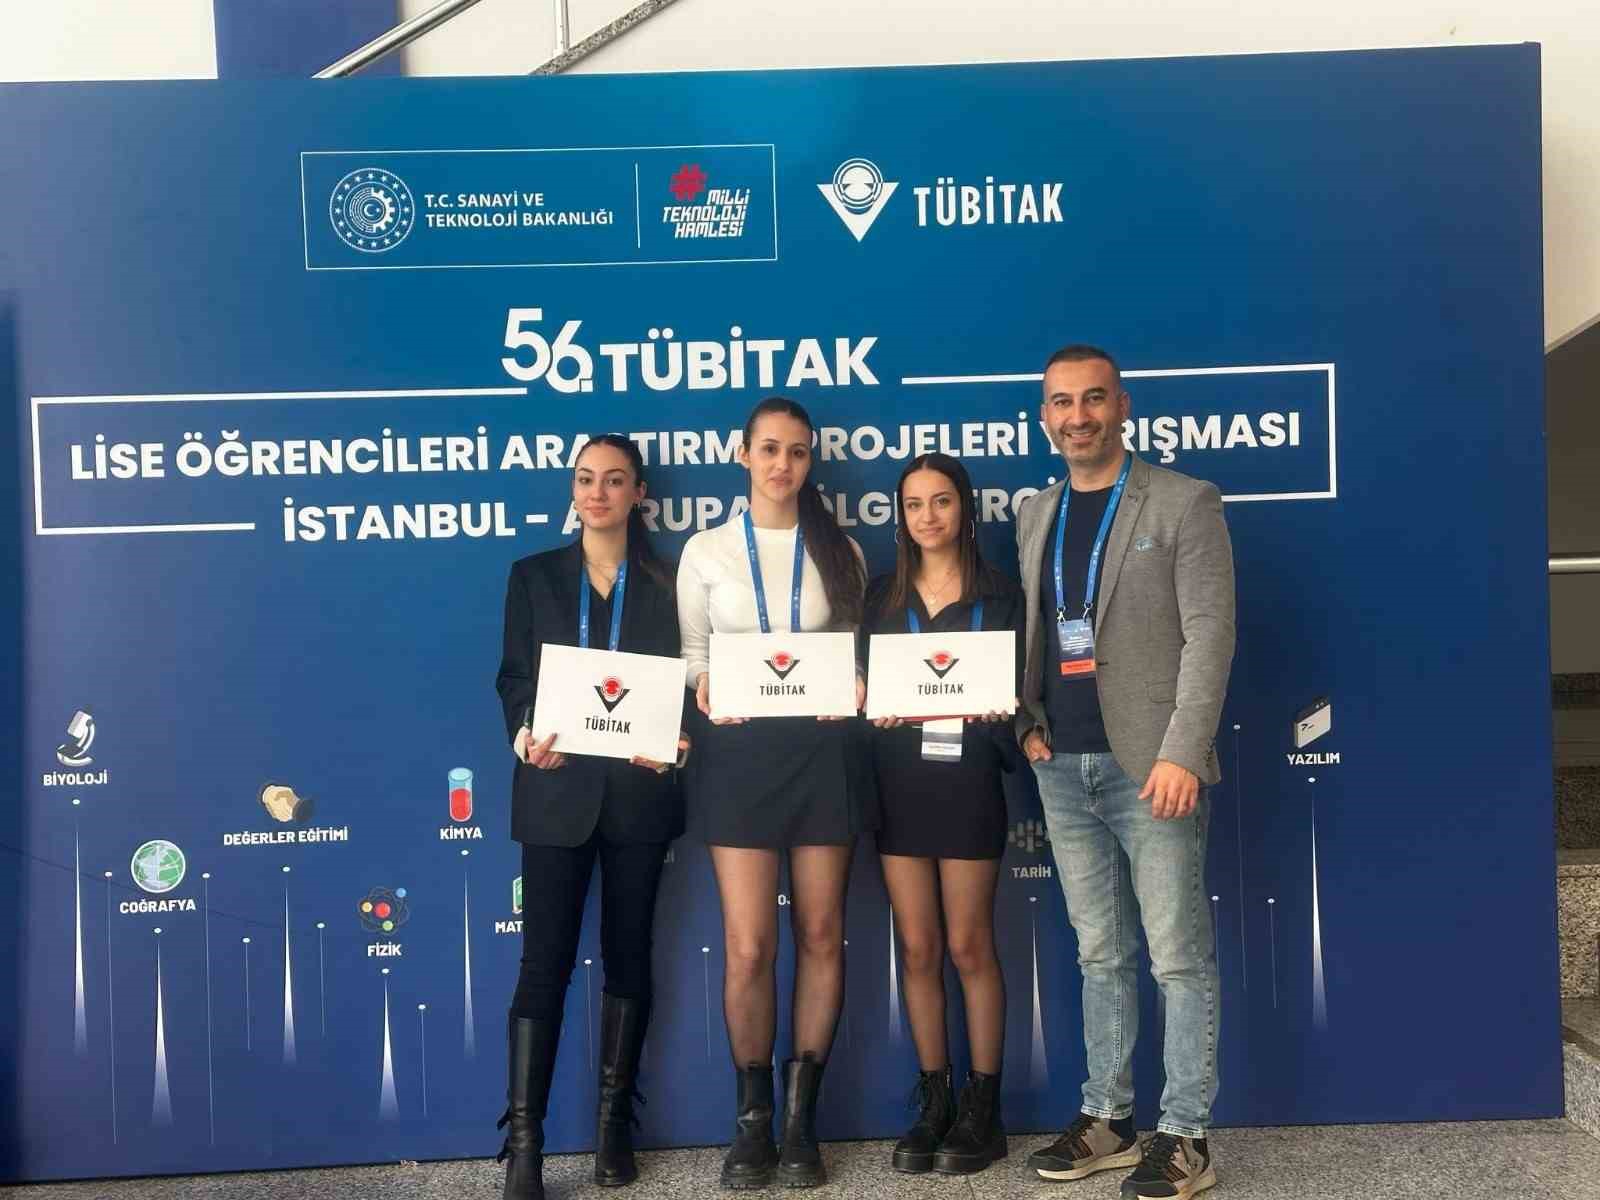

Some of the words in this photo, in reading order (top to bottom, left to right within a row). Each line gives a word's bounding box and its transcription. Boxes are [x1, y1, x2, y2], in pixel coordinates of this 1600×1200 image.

[424, 194, 454, 208] T.C.
[458, 190, 518, 208] SANAYİ
[523, 193, 544, 206] VE
[913, 176, 1064, 226] TÜBİTAK
[426, 210, 518, 228] TEKNOLOJİ
[523, 208, 613, 226] BAKANLIĞI
[662, 205, 747, 223] TEKNOLOJİ
[674, 220, 744, 238] HAMLESİ
[599, 325, 880, 391] TÜBİTAK
[71, 433, 165, 480] LİSE
[176, 425, 488, 478] ÖĞRENCİLERİ
[499, 430, 744, 470] ARTIRM
[811, 411, 1029, 461] ROJELERİ
[1039, 411, 1300, 464] RIŞMASI
[283, 496, 516, 542] İSTANBUL
[759, 682, 806, 697] TÜBİTAK
[918, 680, 965, 696] TÜBİTAK
[584, 715, 631, 735] TÜBİTAK
[1287, 752, 1341, 766] YAZILIM
[43, 769, 108, 787] BİYOLOJİ
[223, 830, 296, 846] DEĞERLER
[298, 826, 349, 843] EĞİTİMİ
[440, 826, 483, 840] KİMYA
[1012, 863, 1052, 879] TARİH
[119, 898, 196, 914] COĞRAFYA
[367, 942, 402, 957] FİZİK
